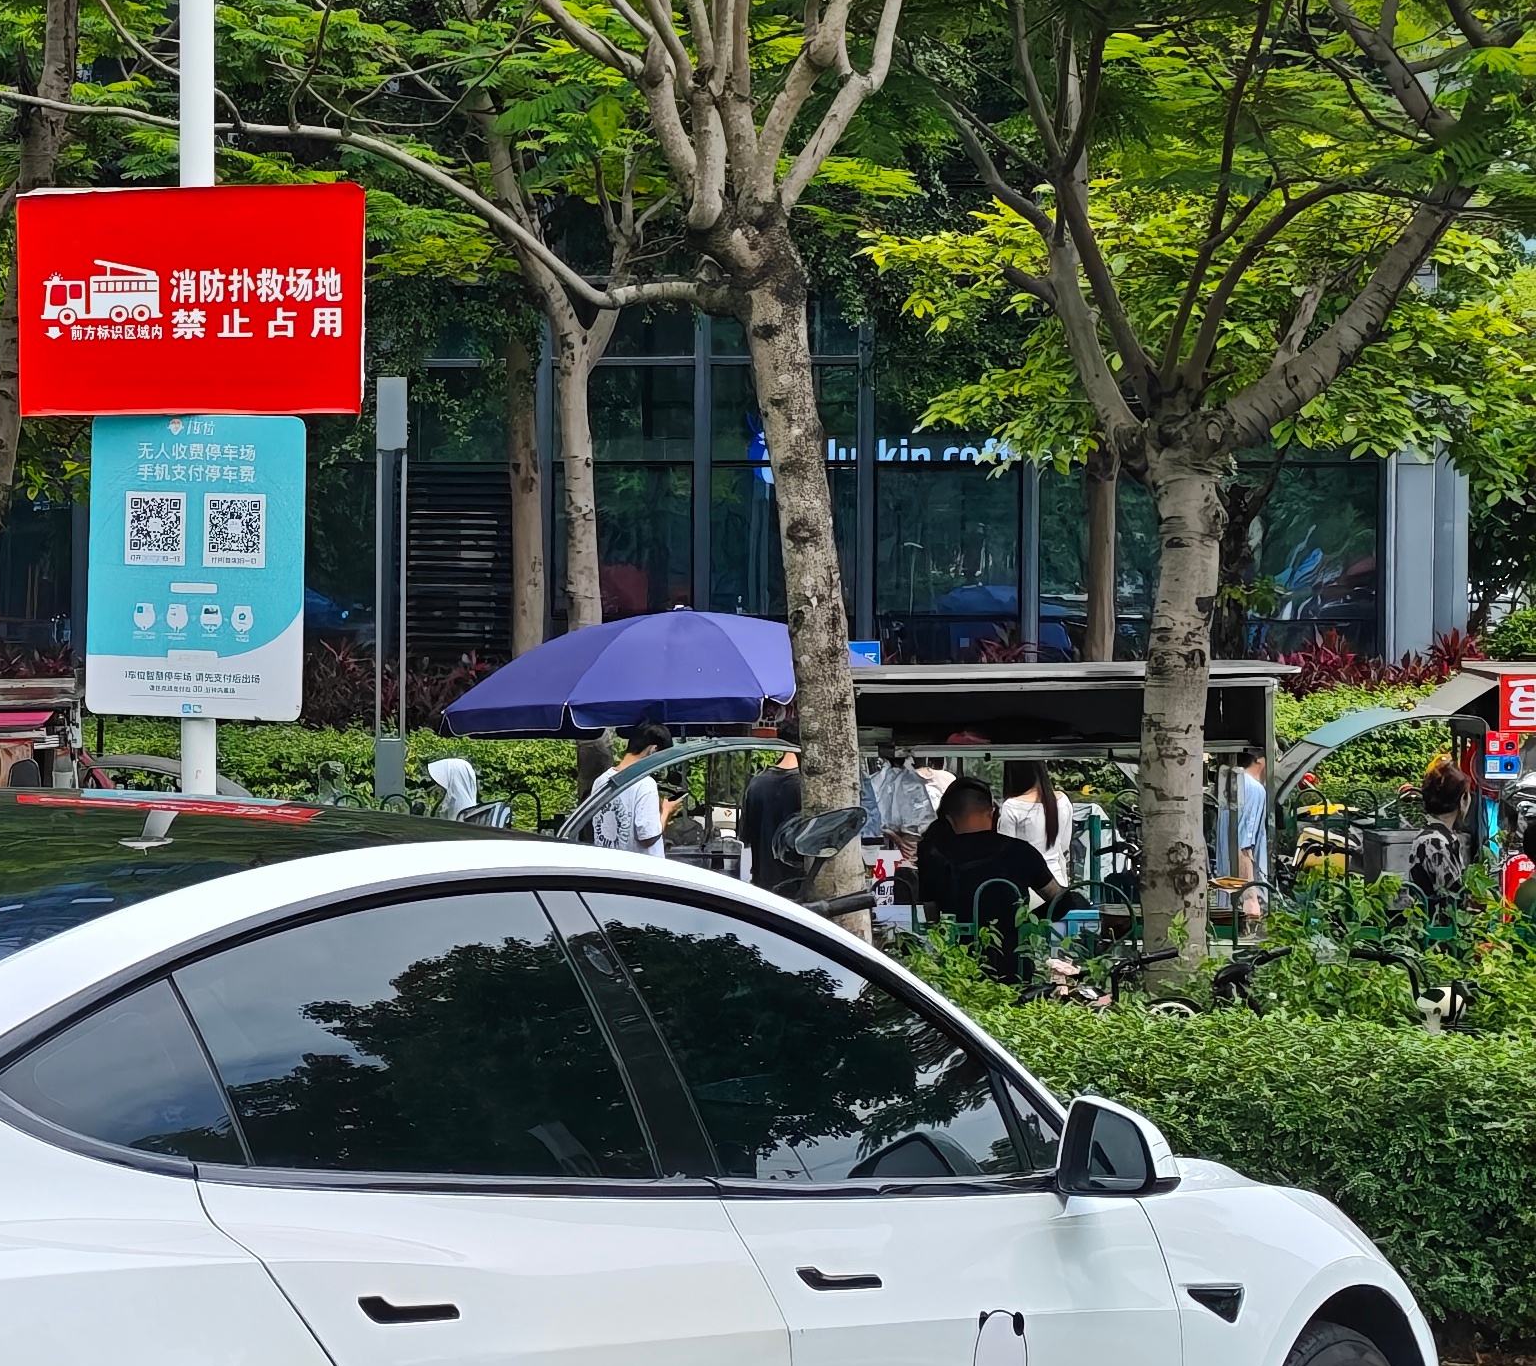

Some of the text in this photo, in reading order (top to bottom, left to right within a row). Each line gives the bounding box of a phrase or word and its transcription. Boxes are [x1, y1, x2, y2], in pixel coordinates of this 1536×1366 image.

[170, 267, 343, 304] 消防扑救场地
[69, 325, 164, 342] 前方标识区域内
[171, 307, 343, 340] 禁止占用
[137, 442, 256, 462] 无人收费停车场
[827, 438, 931, 469] lukin
[136, 463, 256, 483] 手机支付停车费
